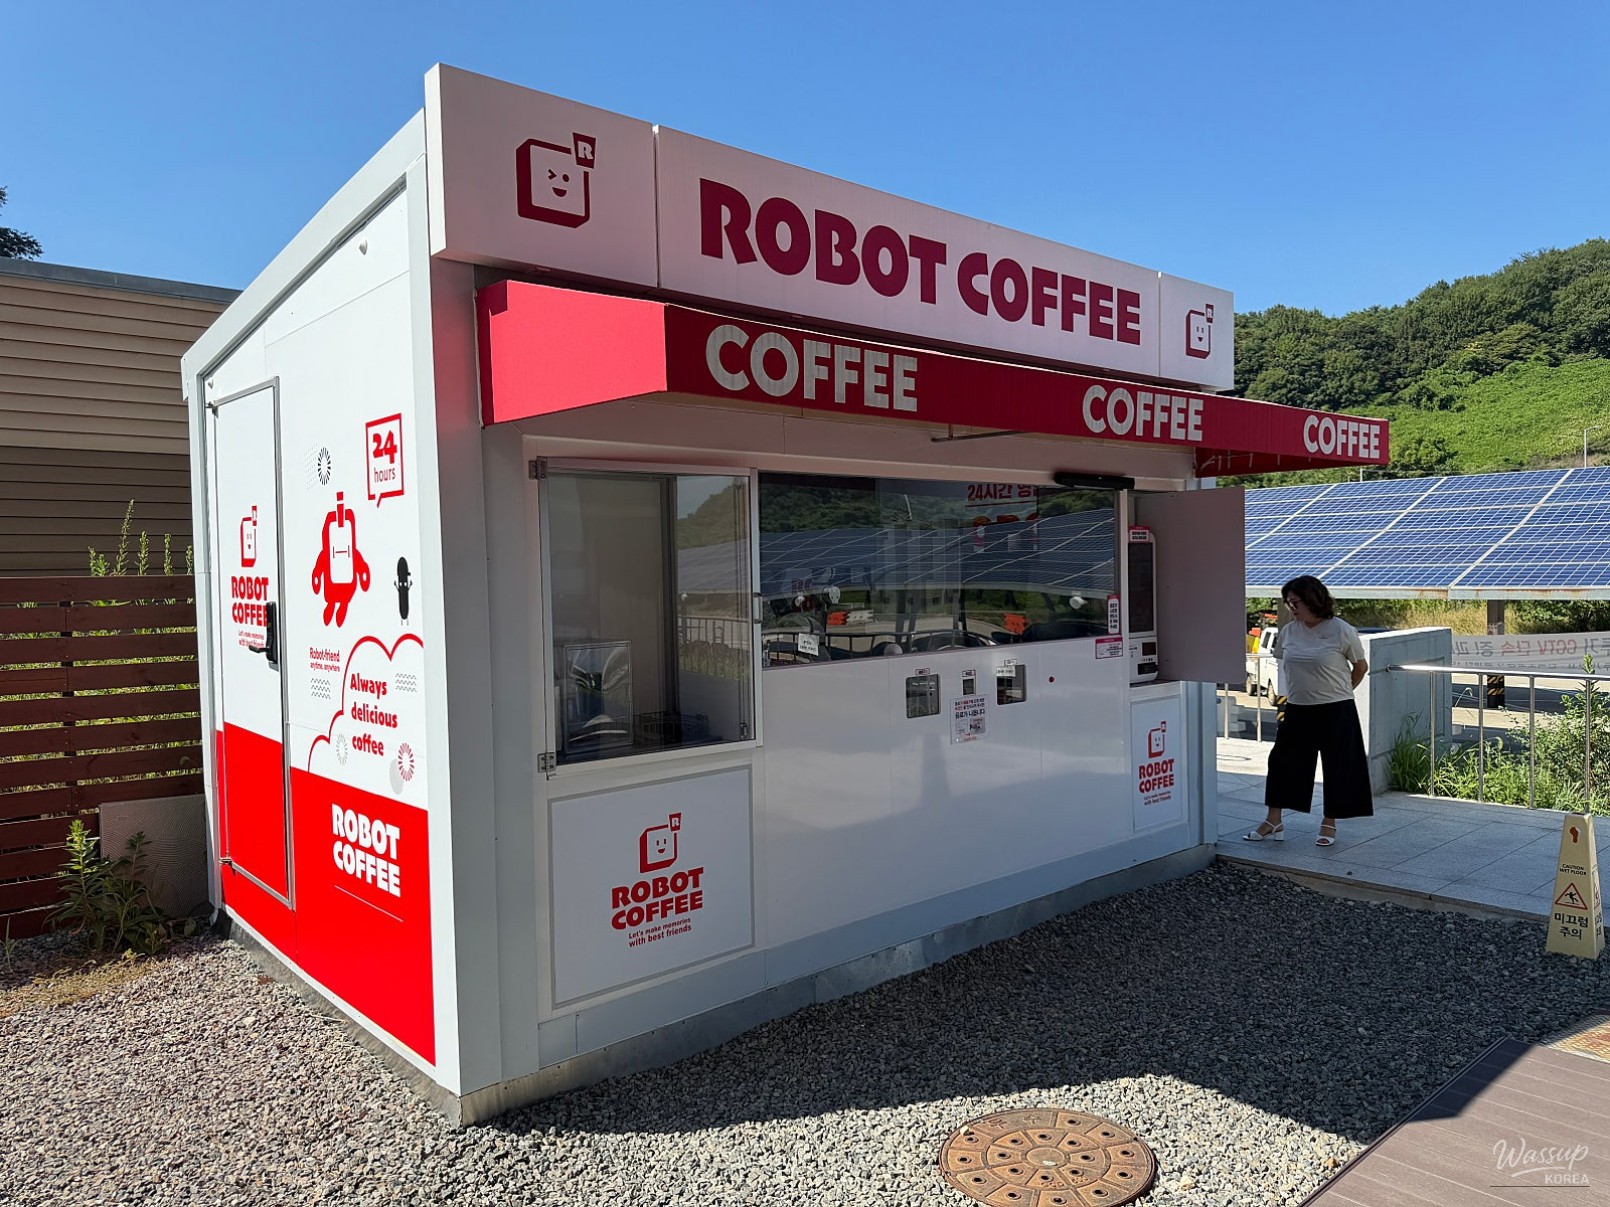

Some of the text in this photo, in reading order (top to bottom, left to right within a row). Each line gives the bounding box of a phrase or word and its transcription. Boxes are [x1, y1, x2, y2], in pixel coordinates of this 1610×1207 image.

[699, 177, 1141, 346] ROBOT COFFEE
[705, 324, 918, 413] COFFEE
[1082, 383, 1203, 442] COFFEE
[372, 429, 398, 464] 24
[1303, 414, 1381, 459] COFFEE
[373, 467, 396, 483] hours
[231, 576, 269, 601] ROBOT
[309, 647, 340, 662] Robot-friend
[350, 673, 388, 698] Always
[351, 701, 398, 729] delicious
[352, 733, 384, 757] coffee
[1138, 758, 1175, 779] ROBOT
[1138, 773, 1175, 794] COFFEE
[331, 803, 400, 860] ROBOT
[333, 840, 401, 898] COFFEE
[611, 866, 704, 910] ROBOT
[611, 889, 703, 931] COFFEE
[1554, 912, 1589, 928] 미끄럼
[628, 917, 691, 940] Let's make memories
[628, 924, 692, 948] with best friends
[1559, 926, 1582, 941] 주의
